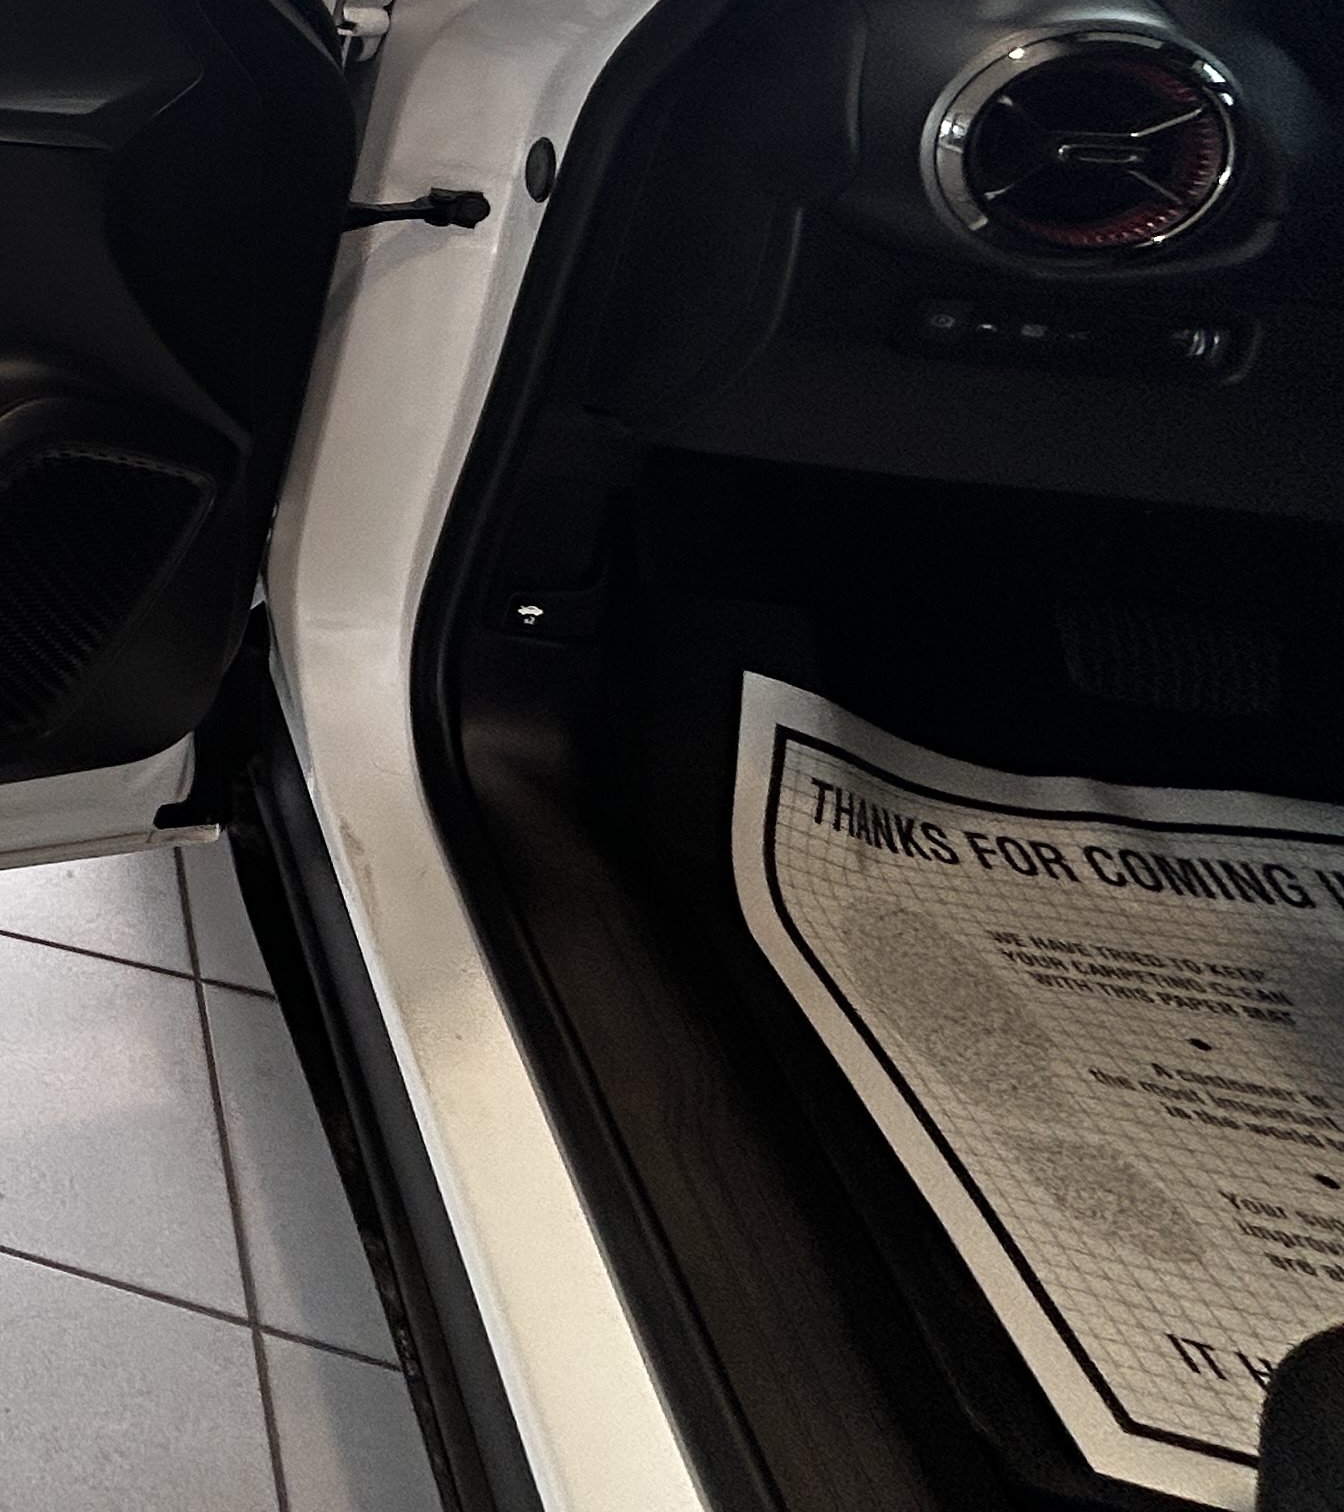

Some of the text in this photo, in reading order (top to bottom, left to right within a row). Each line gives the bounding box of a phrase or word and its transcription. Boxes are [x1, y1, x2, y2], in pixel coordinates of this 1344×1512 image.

[811, 777, 960, 865] THANKS
[964, 831, 1081, 884] FOR
[1083, 845, 1317, 909] COMING
[986, 930, 1265, 984] WE HAVE TRIED TO KEEP
[1000, 949, 1294, 1007] YOUR CARPETING CLEAN
[1026, 970, 1094, 993] WITH
[1095, 981, 1155, 1004] THIS
[1154, 990, 1240, 1017] PAPER
[1151, 1062, 1174, 1080] A
[1217, 1189, 1289, 1220] Your
[1232, 1216, 1344, 1256] improv
[1164, 1333, 1228, 1381] IT
